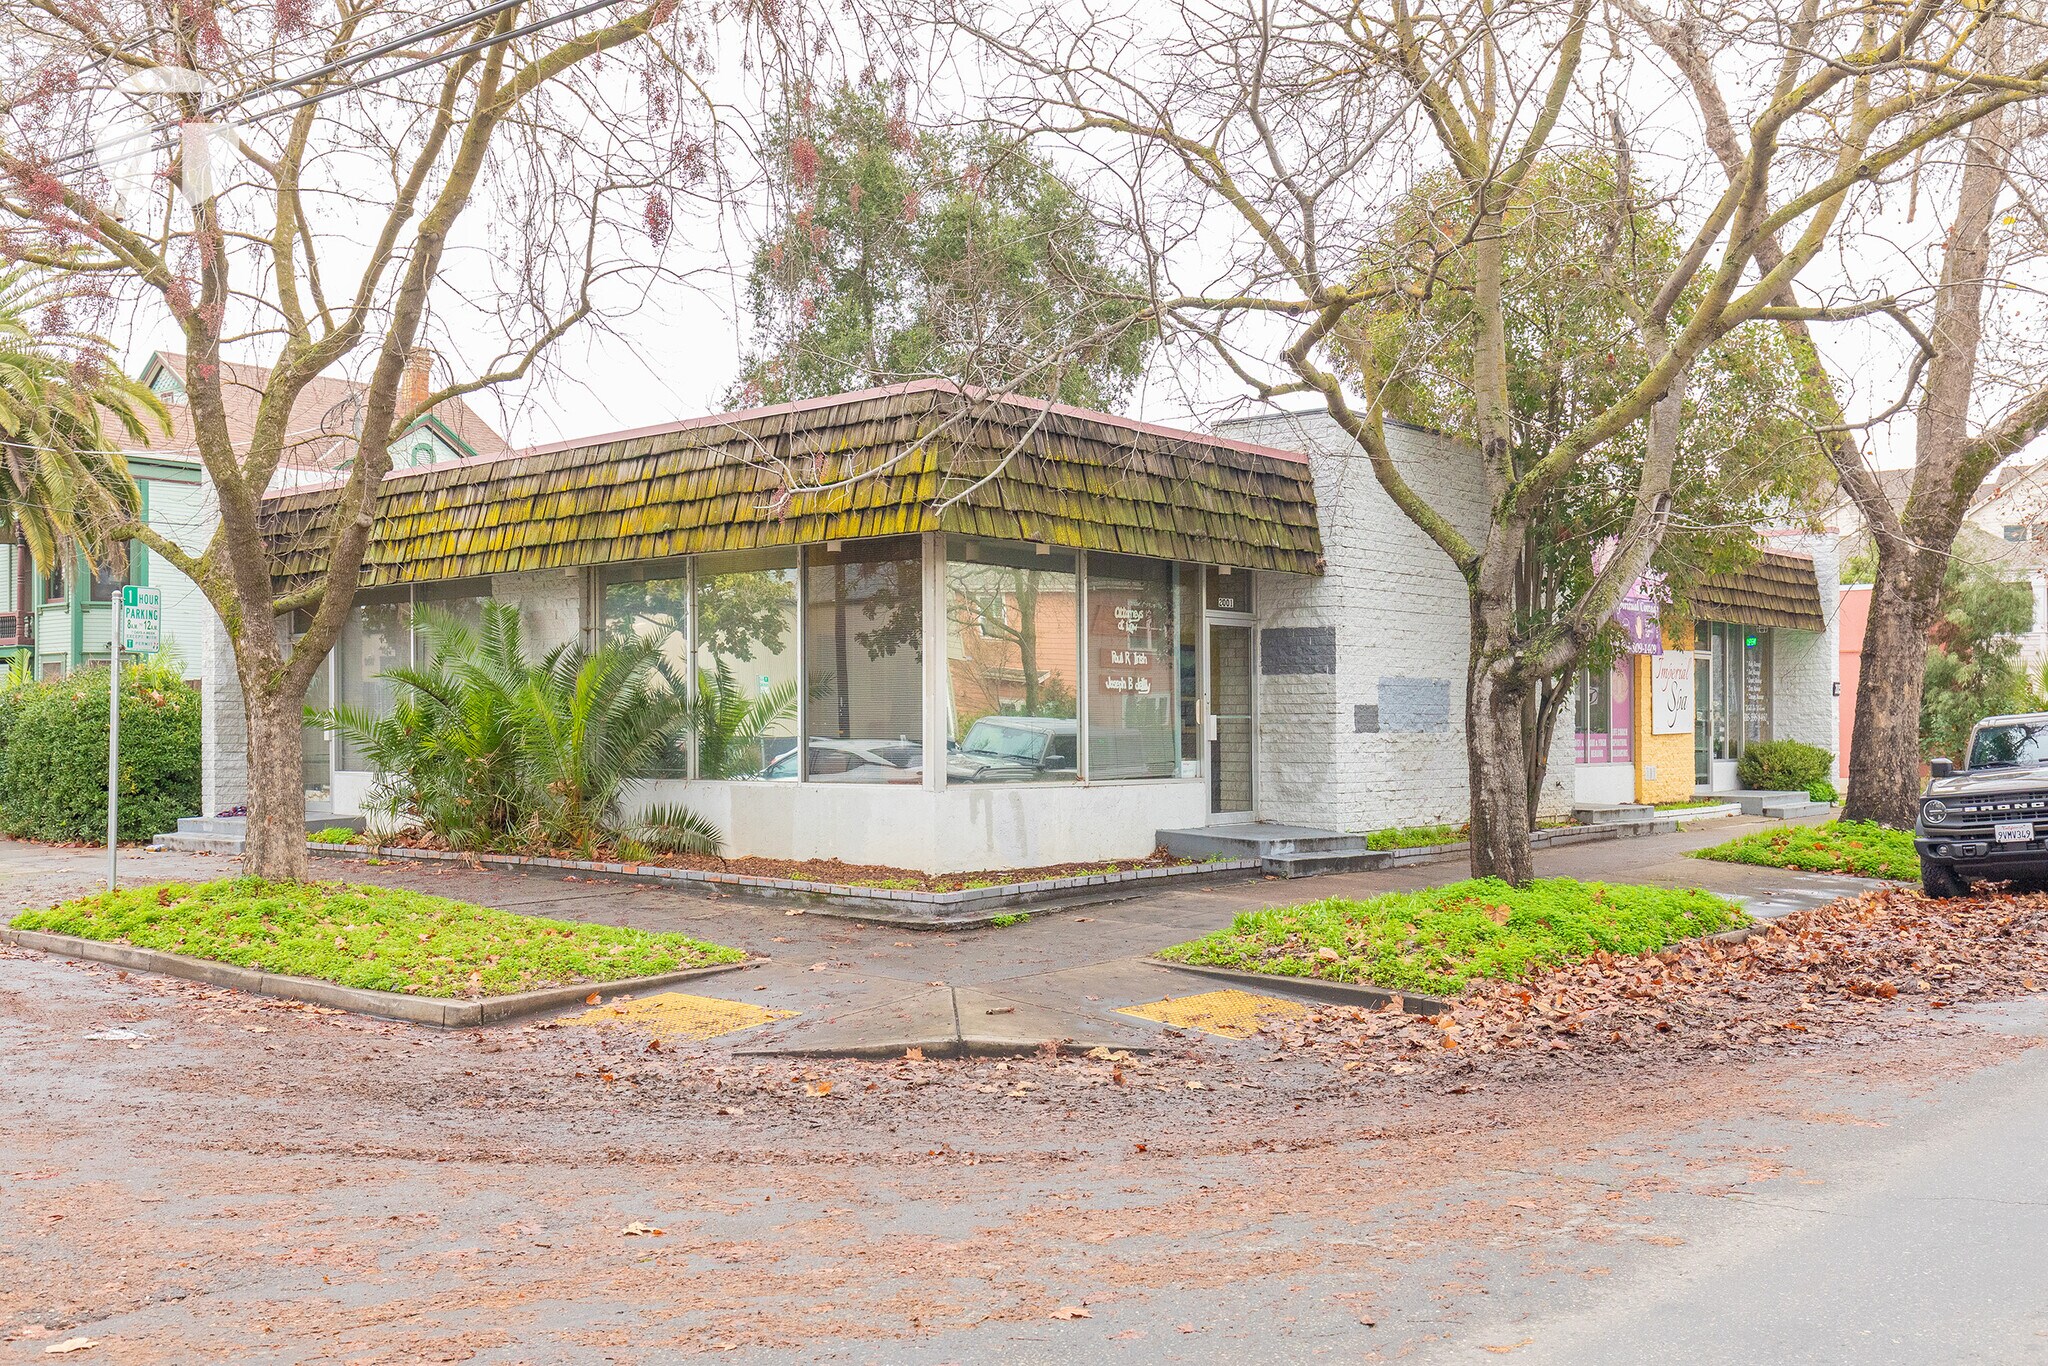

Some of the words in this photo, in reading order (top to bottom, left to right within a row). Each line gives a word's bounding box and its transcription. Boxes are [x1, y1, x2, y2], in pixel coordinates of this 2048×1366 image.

[129, 590, 133, 604] 1
[139, 594, 159, 605] HOUR
[126, 608, 158, 621] PARKING
[1111, 650, 1124, 664] Paul
[1124, 651, 1132, 665] R
[1133, 651, 1148, 665] Irish
[1656, 657, 1692, 692] Imperial
[1105, 676, 1127, 692] Joseph
[1127, 677, 1134, 690] B
[1667, 681, 1688, 728] Spa
[1964, 802, 2046, 812] BRONC
[1998, 830, 2031, 840] 9VMV349
